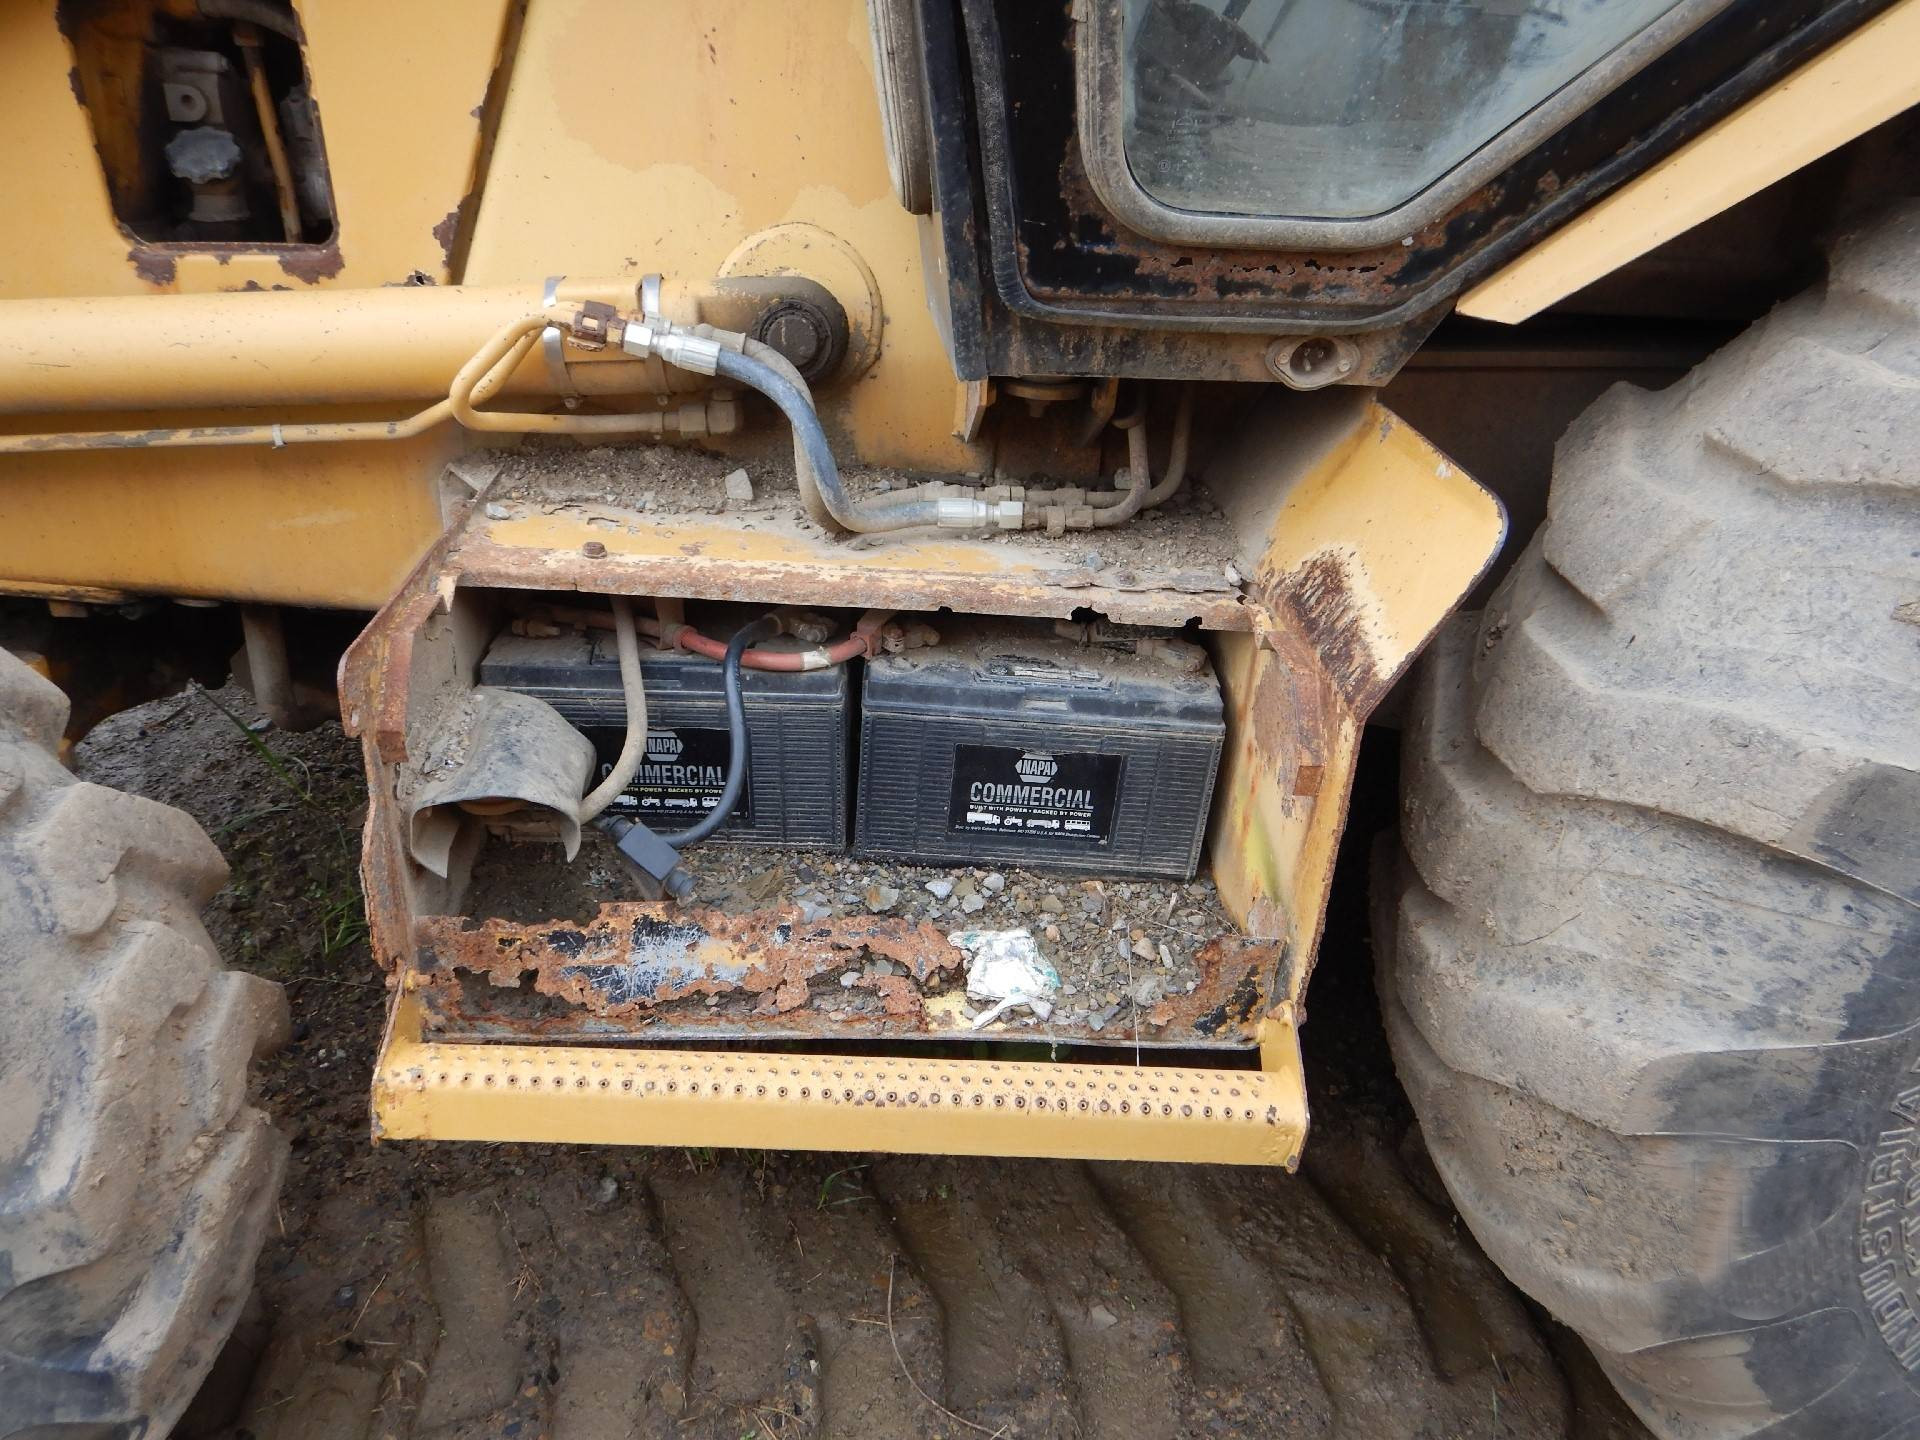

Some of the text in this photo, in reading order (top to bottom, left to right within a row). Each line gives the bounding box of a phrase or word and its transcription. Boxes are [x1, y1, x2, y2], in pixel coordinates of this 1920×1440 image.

[648, 738, 677, 753] NAPA
[602, 763, 726, 785] CMMERCIAL
[1022, 759, 1051, 776] NAPA
[970, 781, 1094, 809] COMMERCIAL
[1033, 808, 1058, 816] BACKED
[1859, 1056, 1920, 1371] INDUSTRIA
